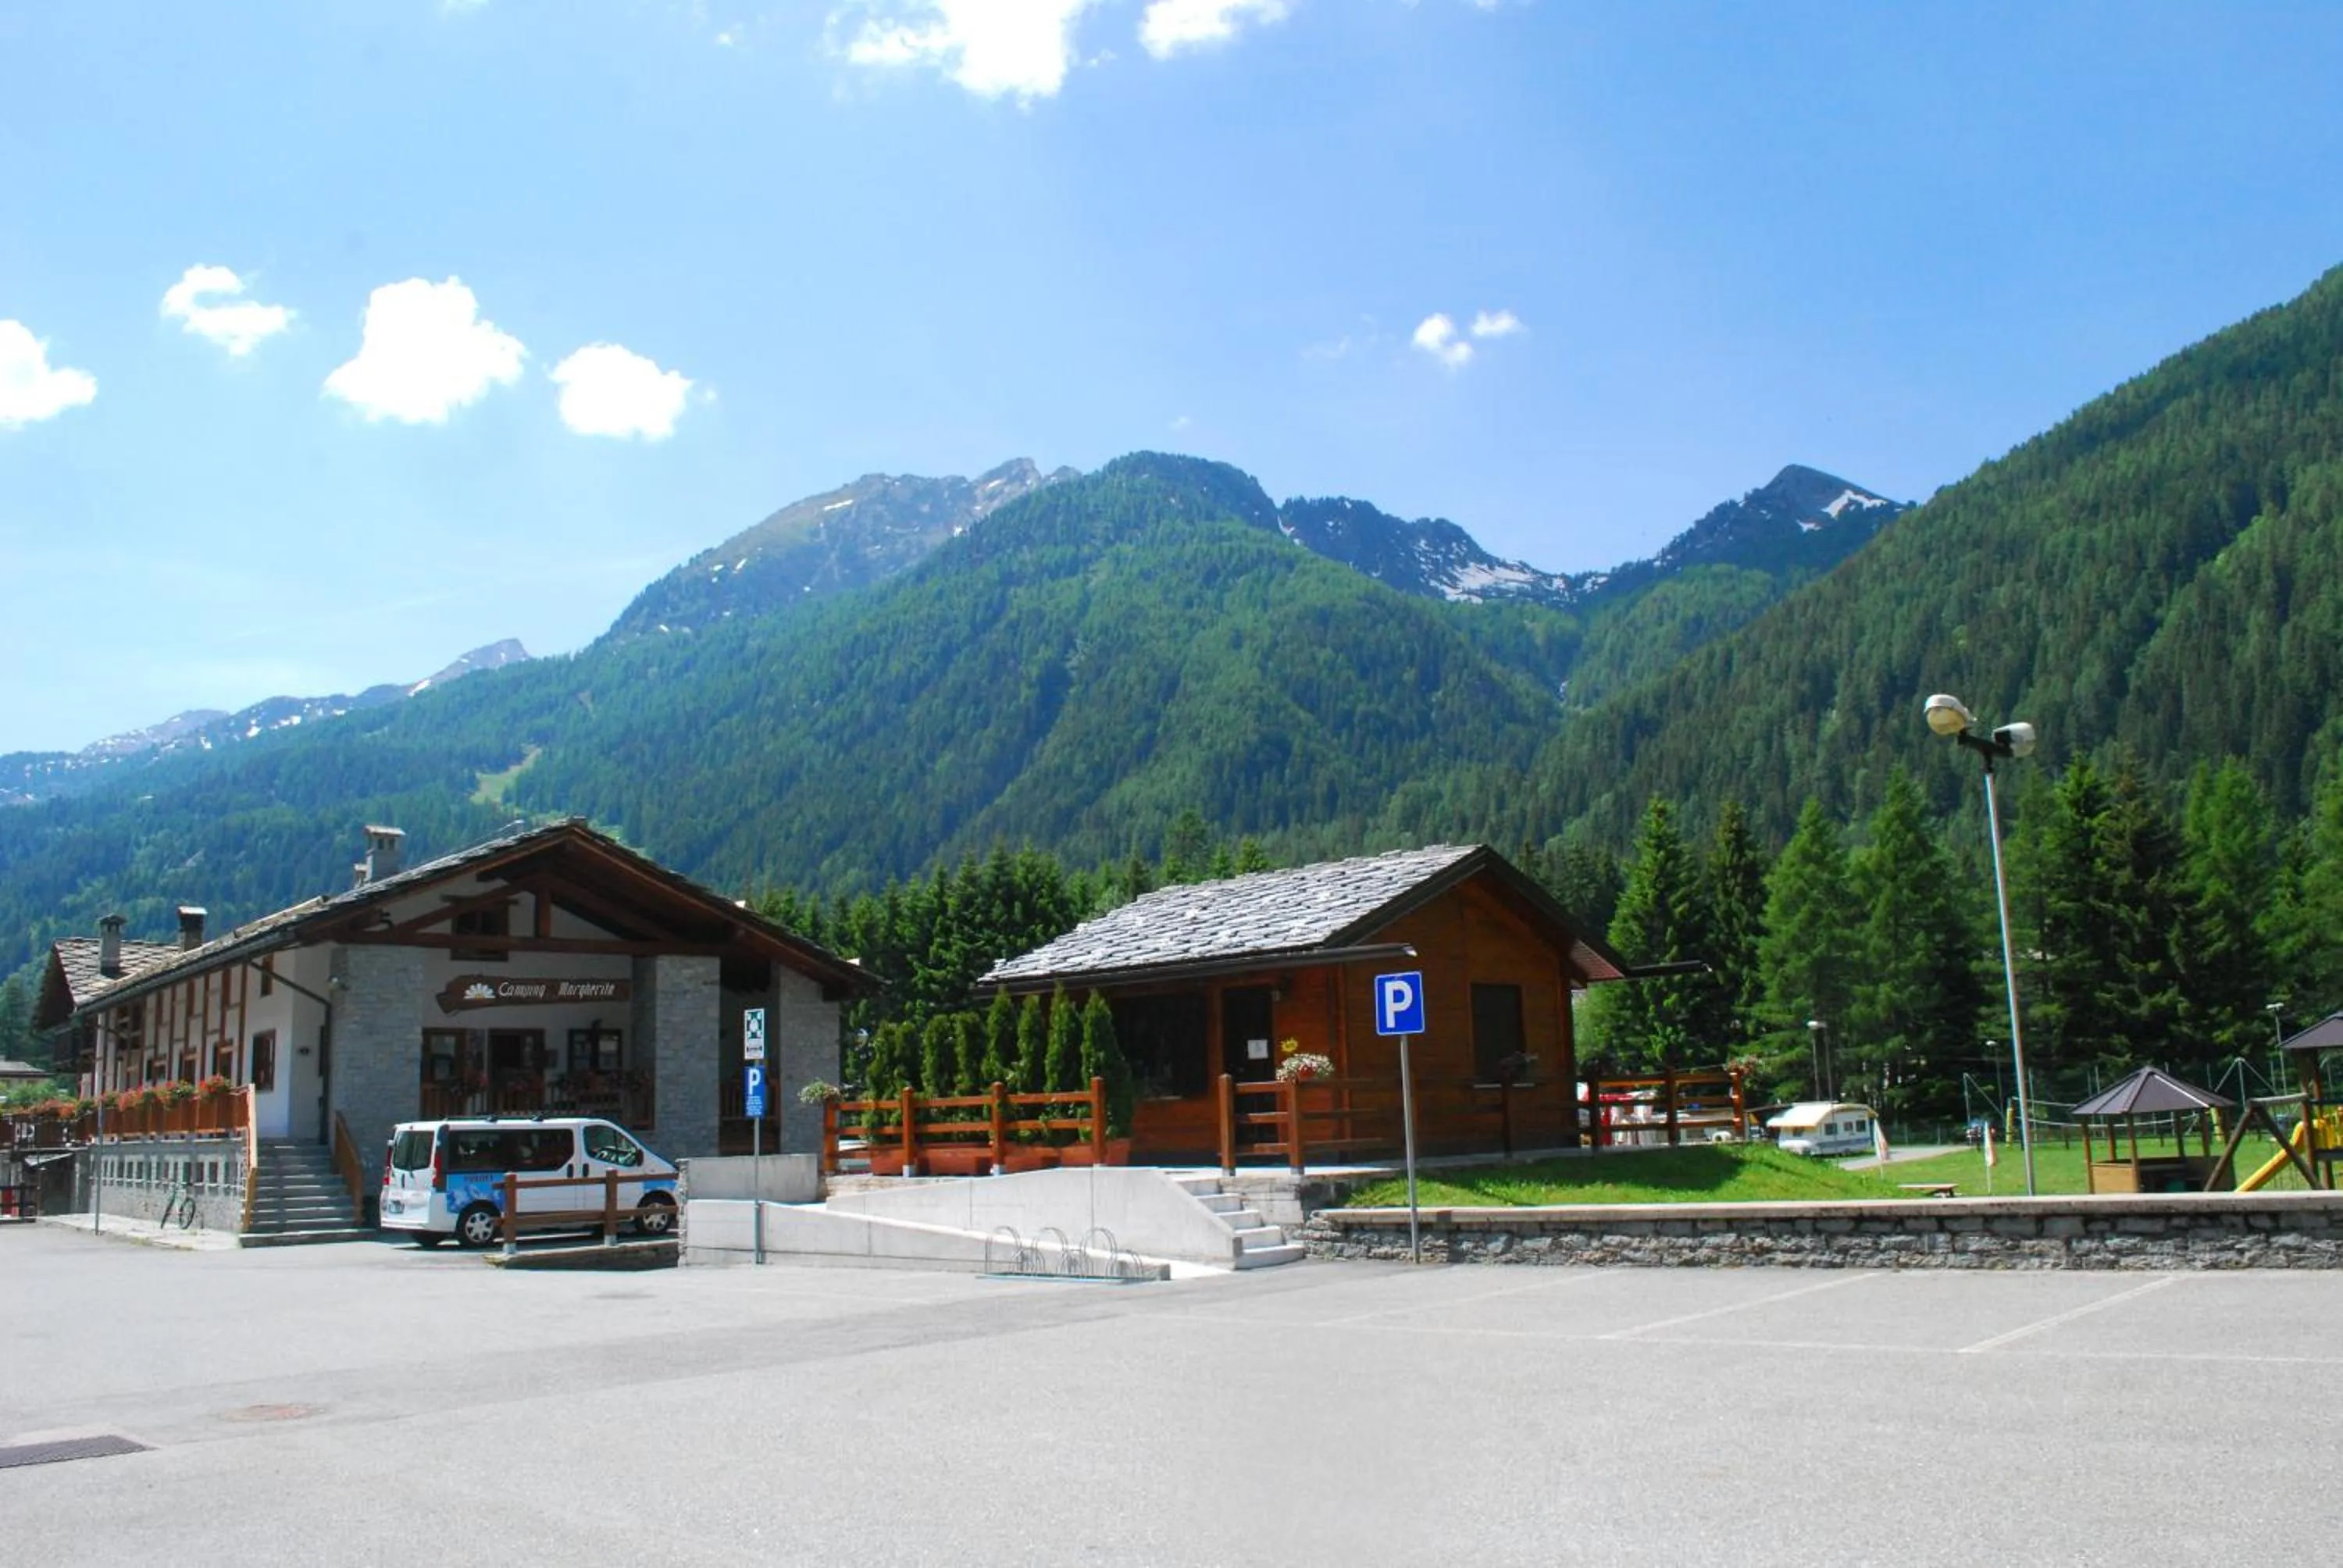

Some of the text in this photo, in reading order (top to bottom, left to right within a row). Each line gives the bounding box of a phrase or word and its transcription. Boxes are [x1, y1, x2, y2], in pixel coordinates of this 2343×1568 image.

[499, 982, 615, 1000] Camping Margherita
[1385, 980, 1413, 1028] P
[748, 1068, 761, 1095] P
